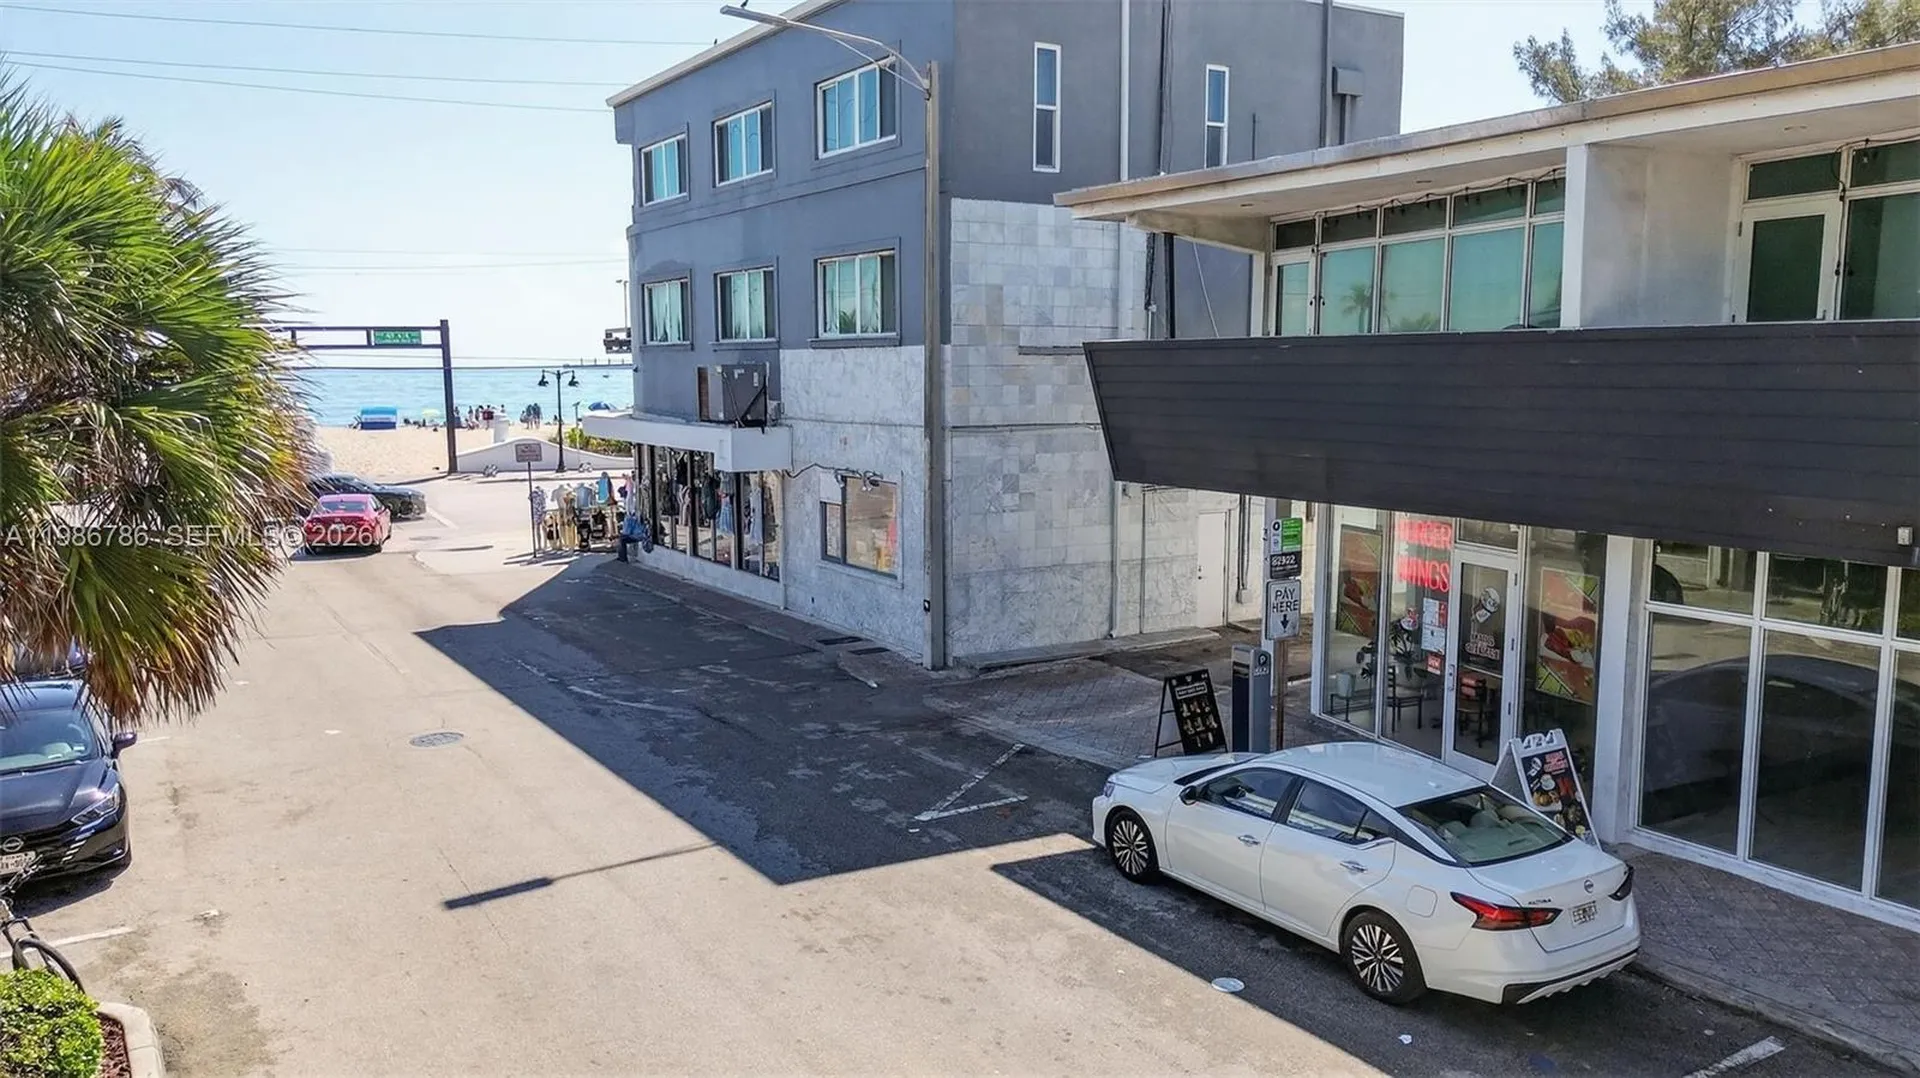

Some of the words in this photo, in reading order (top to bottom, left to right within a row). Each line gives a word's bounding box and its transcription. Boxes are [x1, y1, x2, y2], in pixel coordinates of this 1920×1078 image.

[1397, 556, 1450, 593] WINGS
[1275, 587, 1296, 600] PAY
[1272, 599, 1299, 613] HERE
